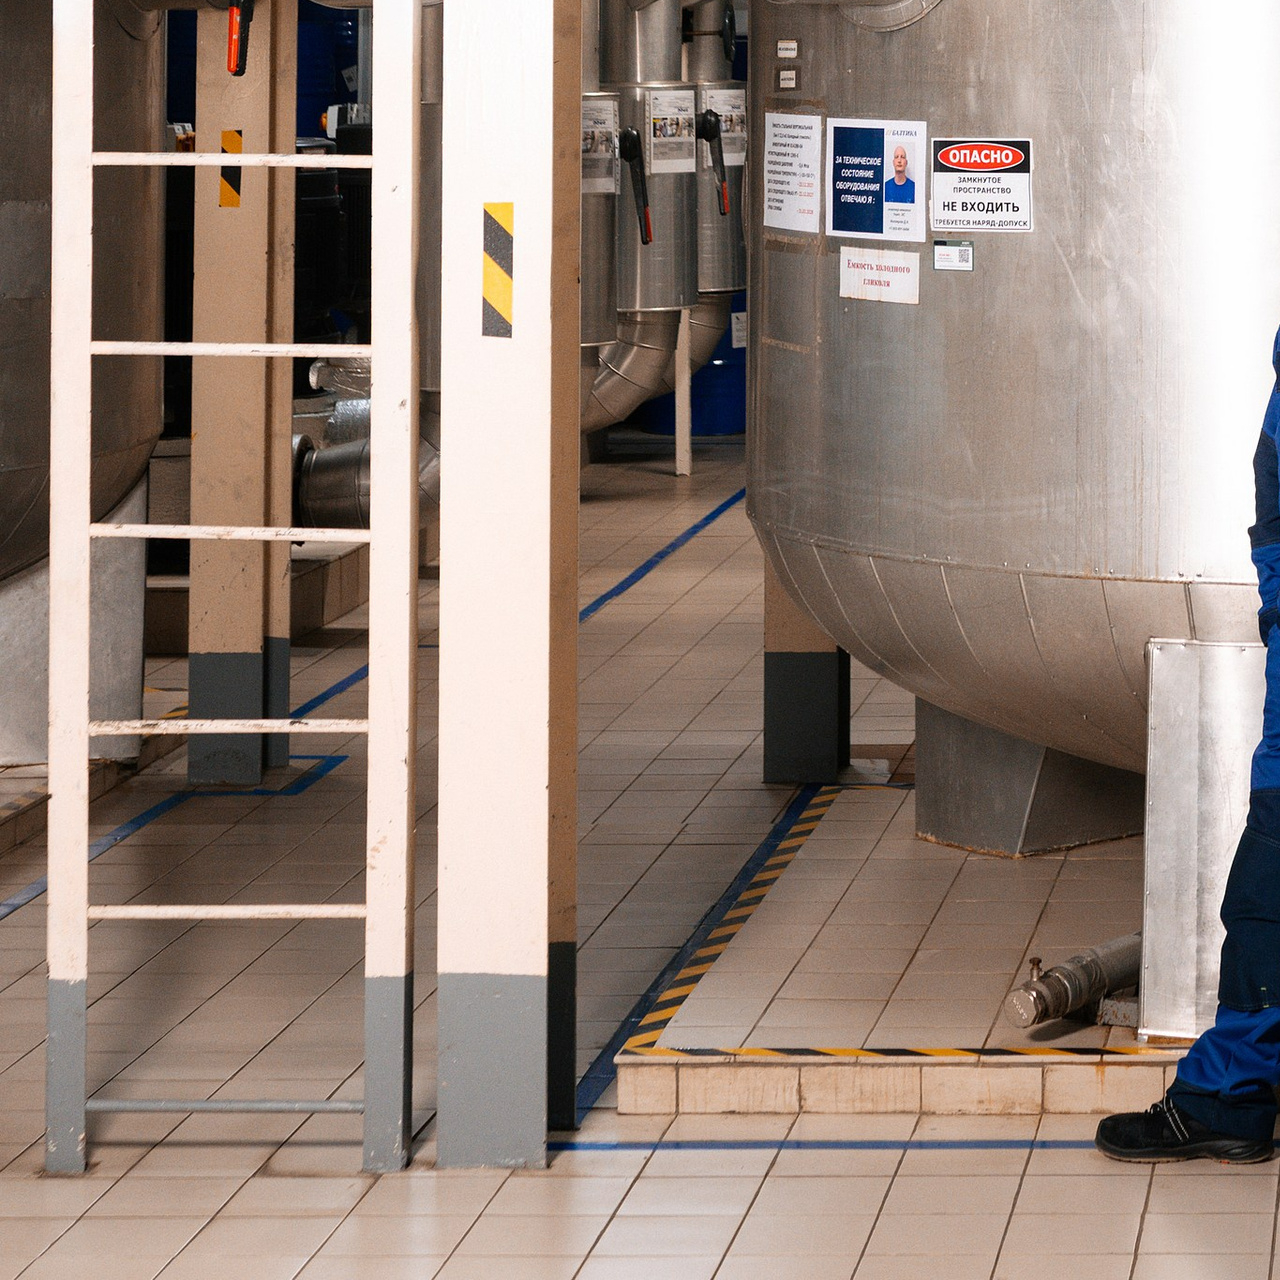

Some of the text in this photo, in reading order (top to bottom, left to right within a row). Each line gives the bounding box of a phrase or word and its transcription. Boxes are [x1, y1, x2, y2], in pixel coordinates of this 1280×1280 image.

[835, 155, 882, 166] ЗА ТЕХНИЧЕСКОЕ
[949, 149, 1013, 164] ОПАСНО
[841, 168, 874, 178] СОСТОЯНИЕ
[957, 176, 1002, 184] ЗАМКНУТОЕ
[835, 181, 880, 192] ОБОРУДОВАНИЯ
[953, 186, 1012, 194] ПРОСТРАНСТВО
[840, 194, 867, 204] ОТВЕЧАЮ
[942, 201, 1020, 214] НЕ ВХОДИТЬ
[935, 218, 1028, 228] ТРЕБУЕТСЯ НАРЯД-ДОПУСК
[847, 259, 911, 273] Емкость холодного
